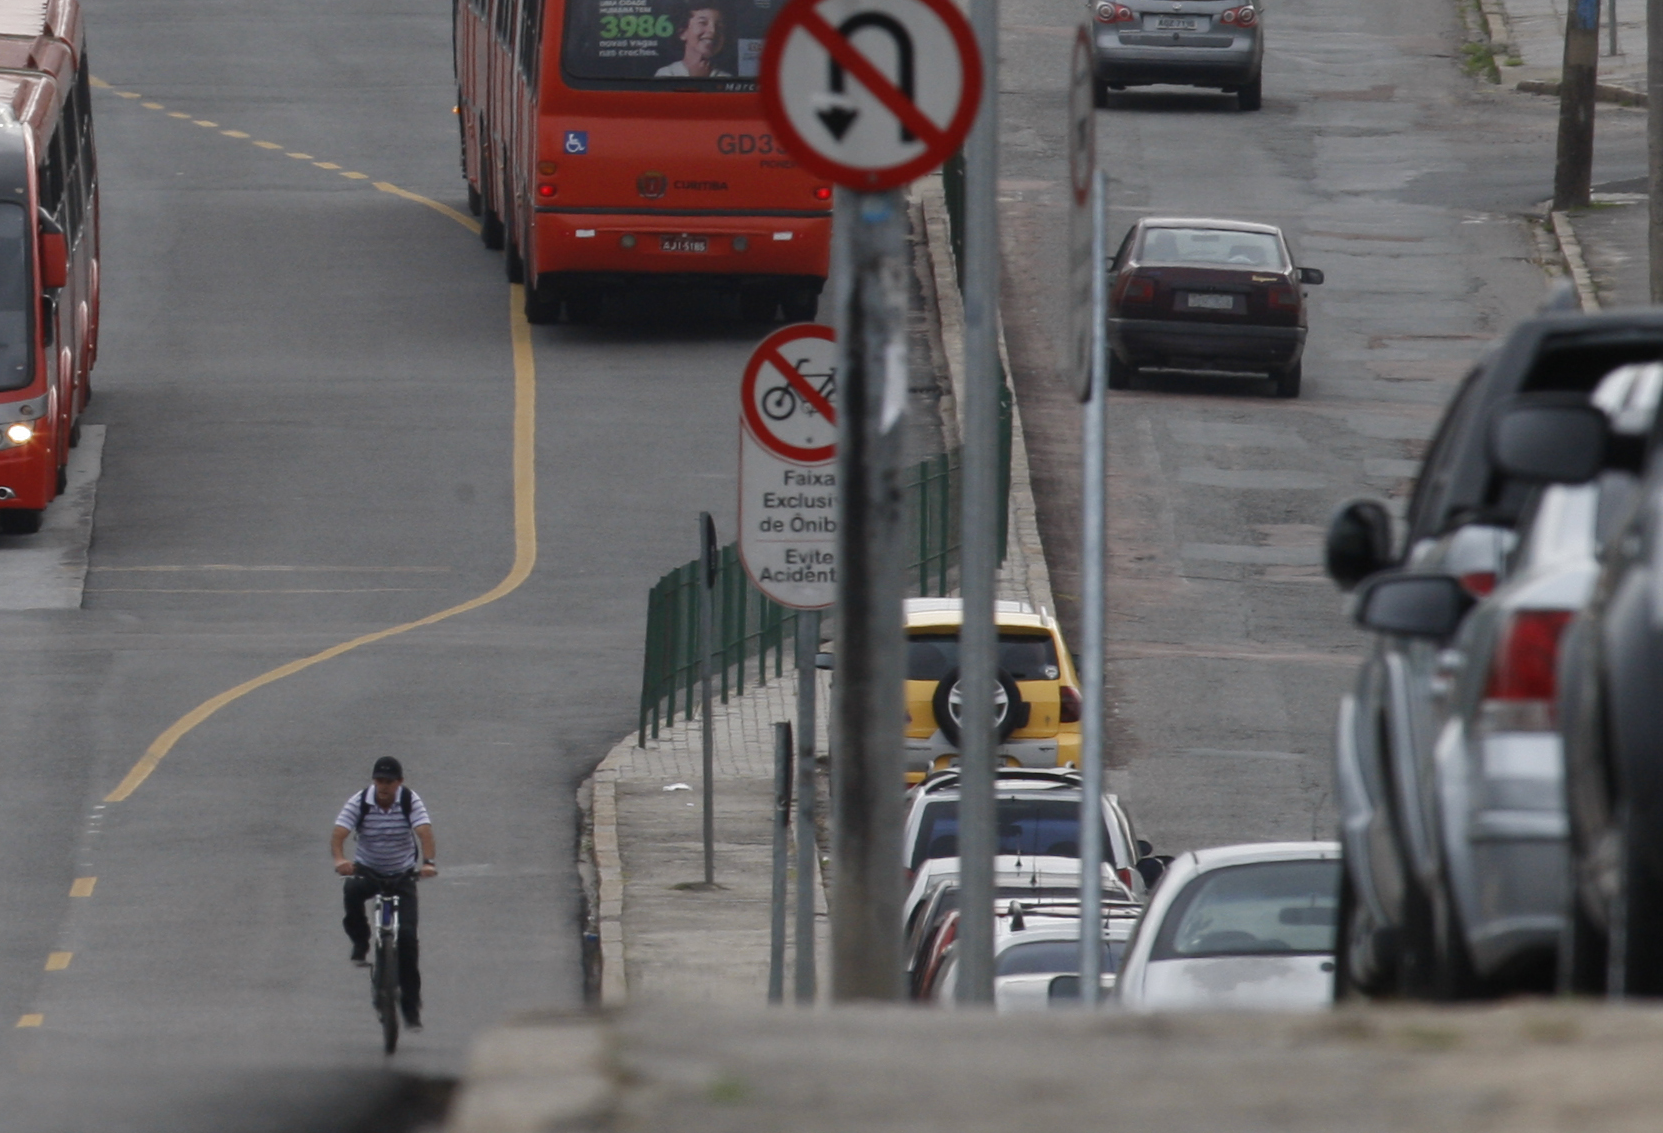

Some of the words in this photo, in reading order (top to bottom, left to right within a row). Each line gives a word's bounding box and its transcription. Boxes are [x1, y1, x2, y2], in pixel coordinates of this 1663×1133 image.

[673, 180, 728, 191] CURITIBA
[783, 470, 837, 486] Faixa
[763, 492, 838, 508] Exclusi
[759, 516, 784, 533] de
[790, 513, 838, 533] Ônib
[785, 548, 835, 565] Evite
[759, 567, 838, 583] Acident
